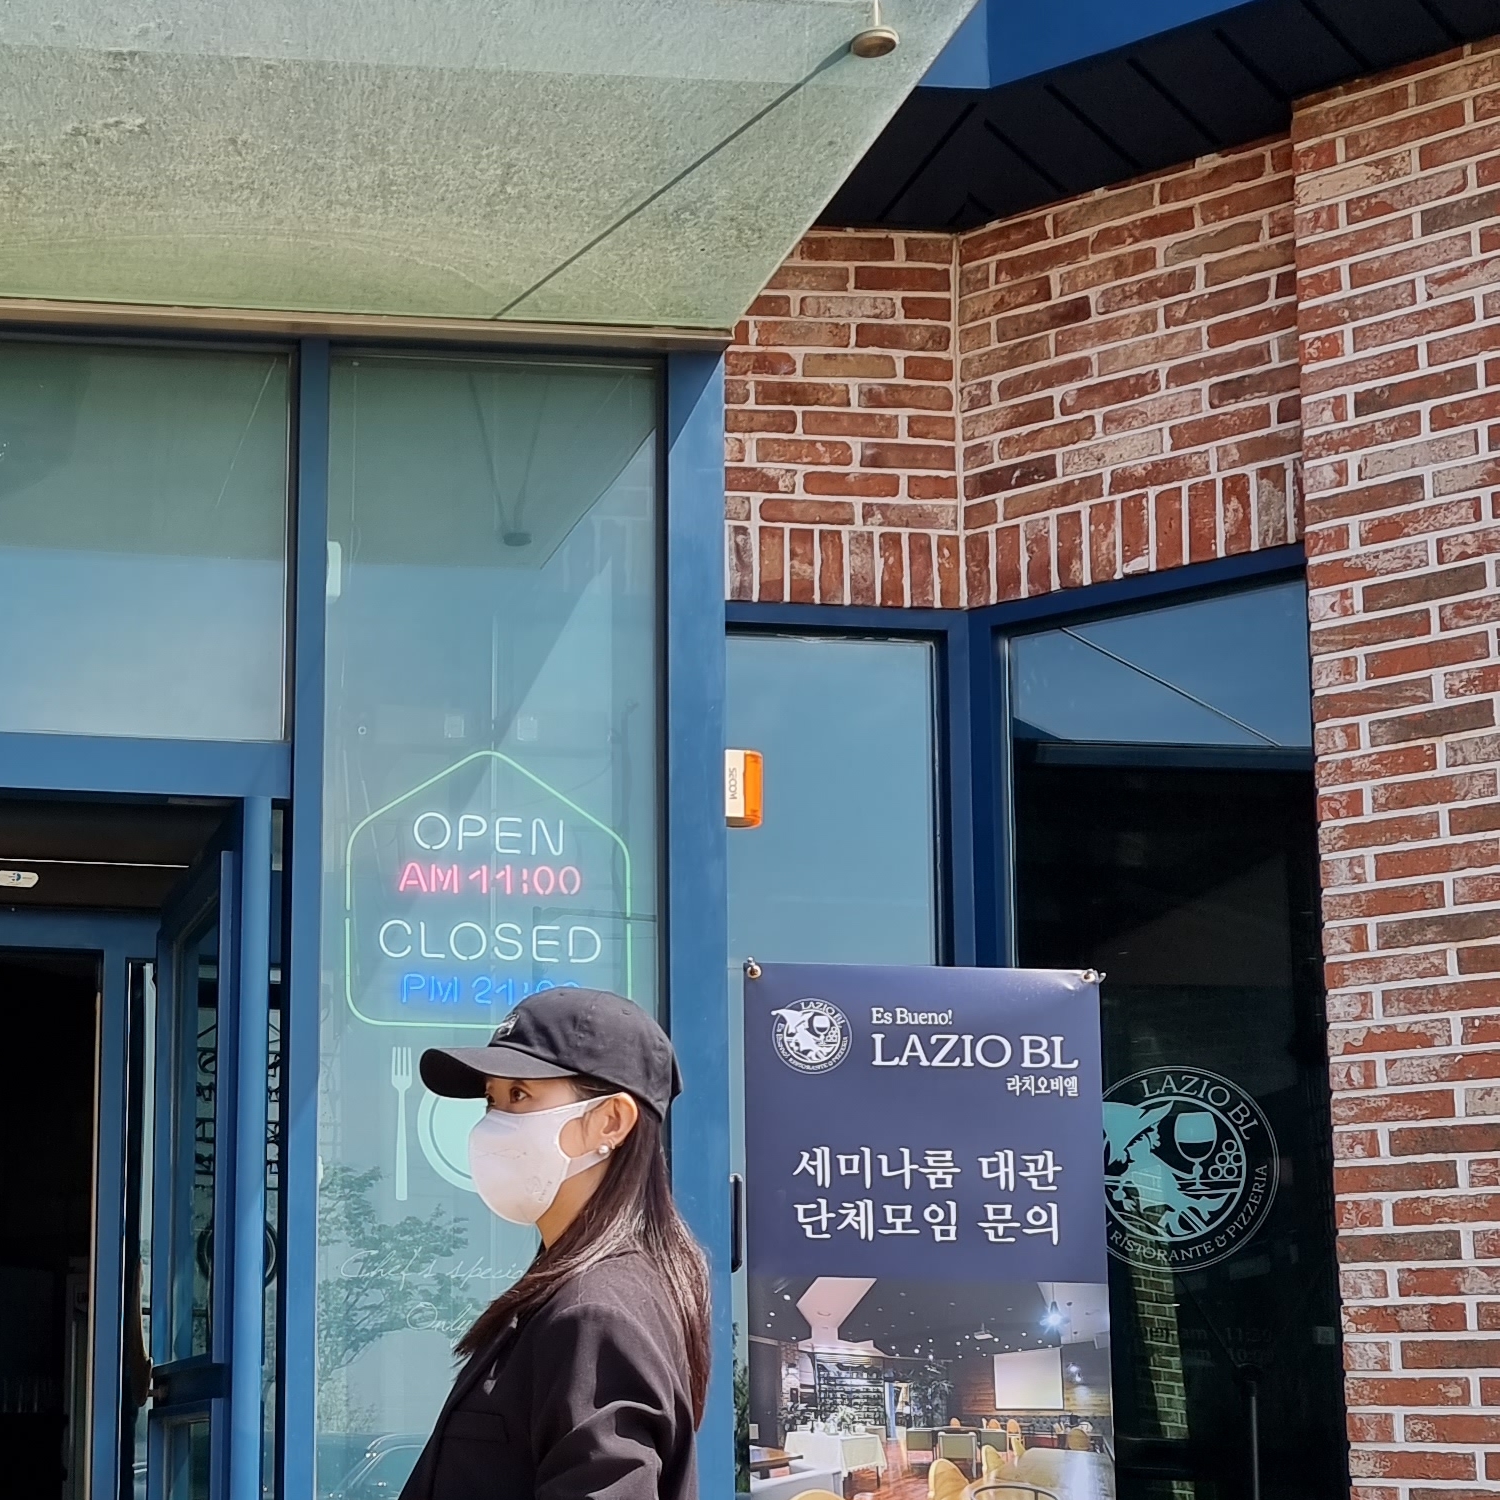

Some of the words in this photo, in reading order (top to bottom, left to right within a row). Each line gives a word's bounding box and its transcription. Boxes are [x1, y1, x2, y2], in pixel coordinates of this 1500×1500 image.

[413, 811, 564, 856] OPEN
[399, 862, 458, 893] AM
[468, 864, 581, 895] 11:00
[379, 919, 601, 963] CLOSED
[401, 973, 458, 1004] PM
[871, 1007, 893, 1025] Es
[895, 1008, 953, 1026] Bueno!
[871, 1034, 1011, 1069] LAZIO
[1020, 1035, 1079, 1070] BL
[1007, 1074, 1079, 1097] 라치오비엘
[1140, 1075, 1230, 1107] LAZIO
[1227, 1101, 1258, 1140] BL
[793, 1146, 961, 1190] 세미나룸
[977, 1149, 1062, 1192] 대관
[793, 1199, 958, 1242] 단체모임
[977, 1203, 1059, 1245] 문의
[1110, 1229, 1215, 1263] RISTORANTE
[1214, 1234, 1227, 1248] &
[1225, 1165, 1268, 1238] PIZZERIA
